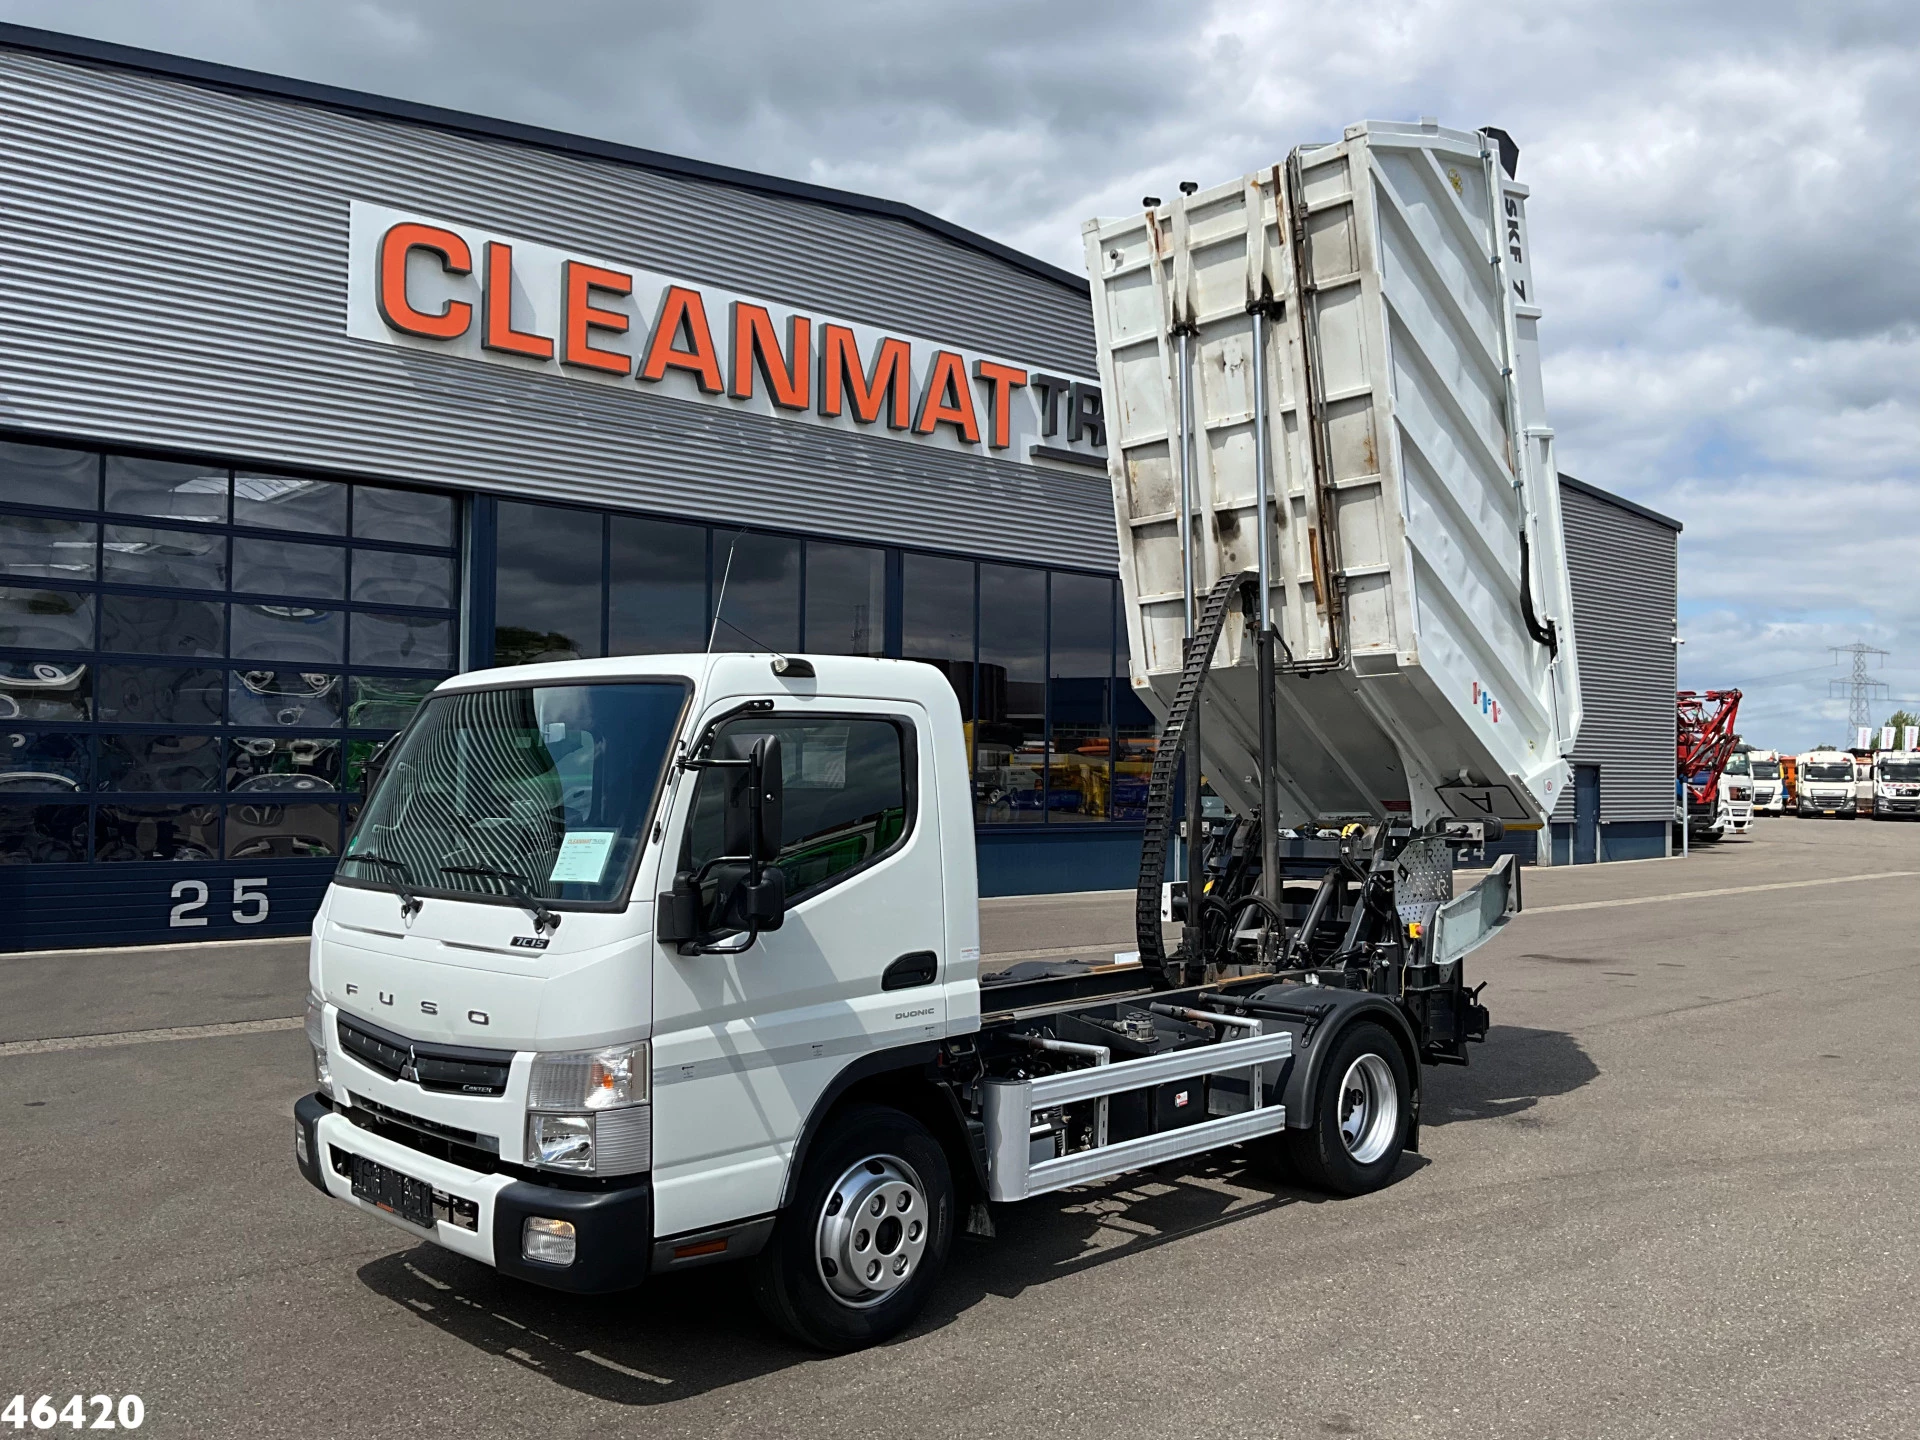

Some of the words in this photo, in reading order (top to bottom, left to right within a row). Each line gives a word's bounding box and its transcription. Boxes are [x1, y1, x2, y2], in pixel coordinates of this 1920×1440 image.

[1505, 197, 1522, 264] SKF
[1512, 279, 1527, 303] 7
[375, 221, 1028, 450] CLEANMAT
[346, 983, 490, 1026] FUSO
[895, 1008, 935, 1020] DUONIC
